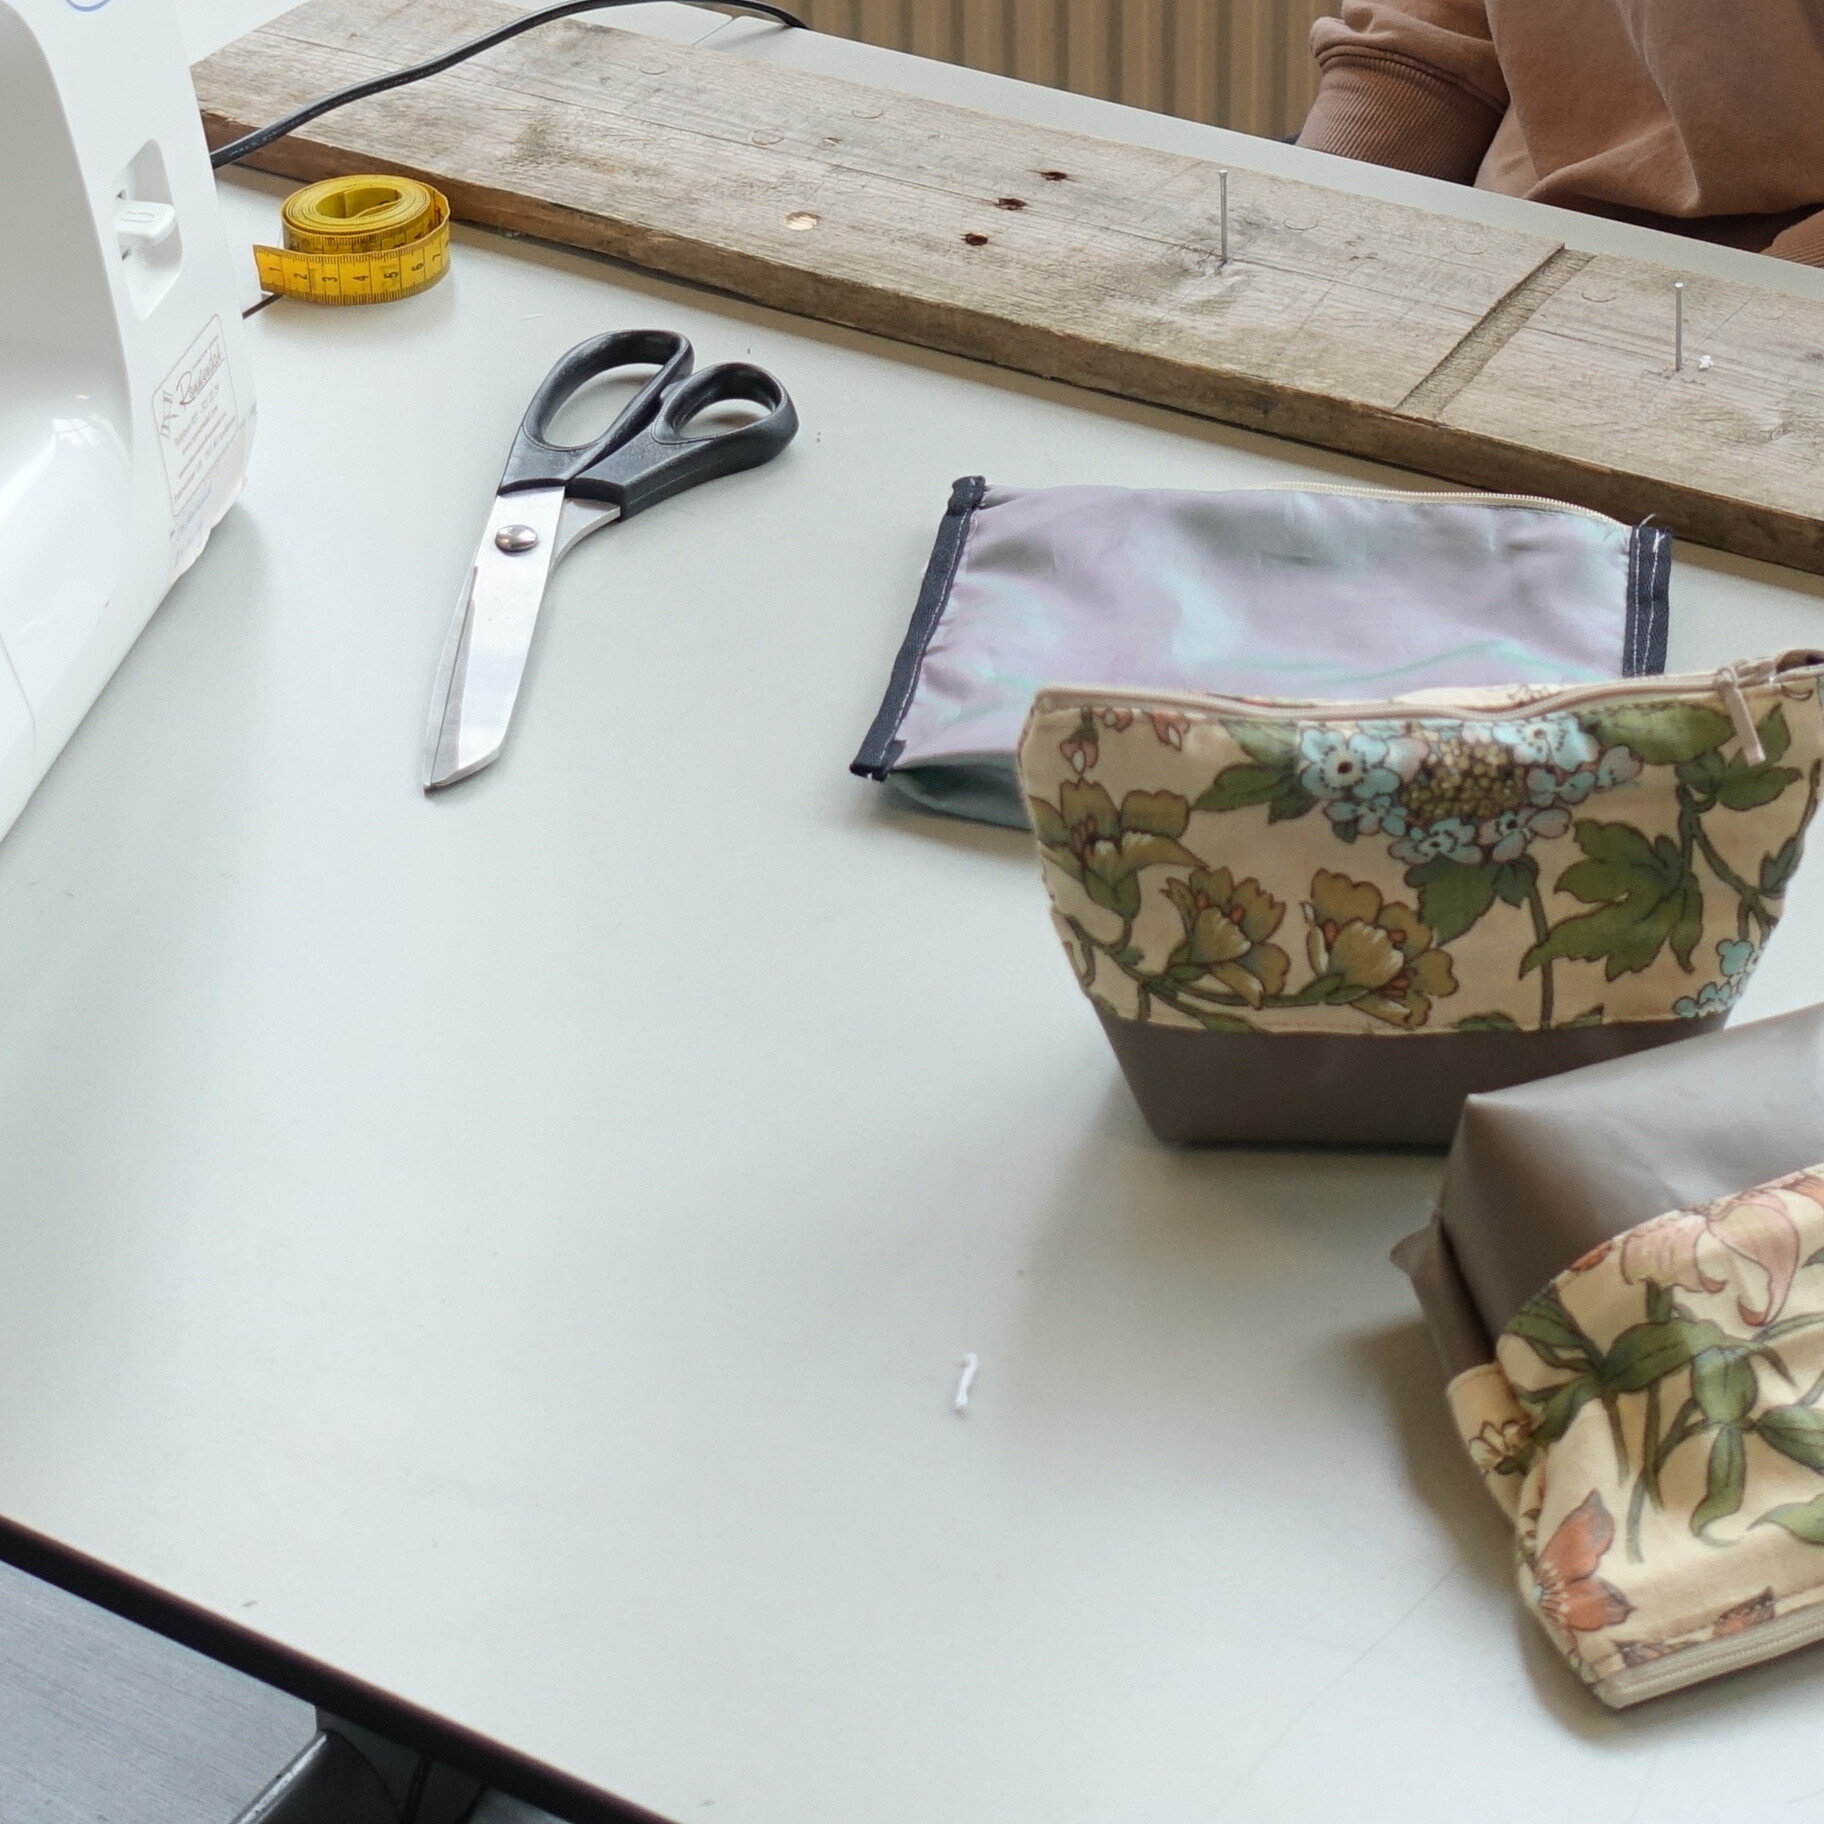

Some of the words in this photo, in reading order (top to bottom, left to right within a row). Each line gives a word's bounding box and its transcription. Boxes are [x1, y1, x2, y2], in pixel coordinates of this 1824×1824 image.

[294, 272, 308, 281] 2
[384, 271, 399, 280] 5
[411, 262, 424, 272] 6
